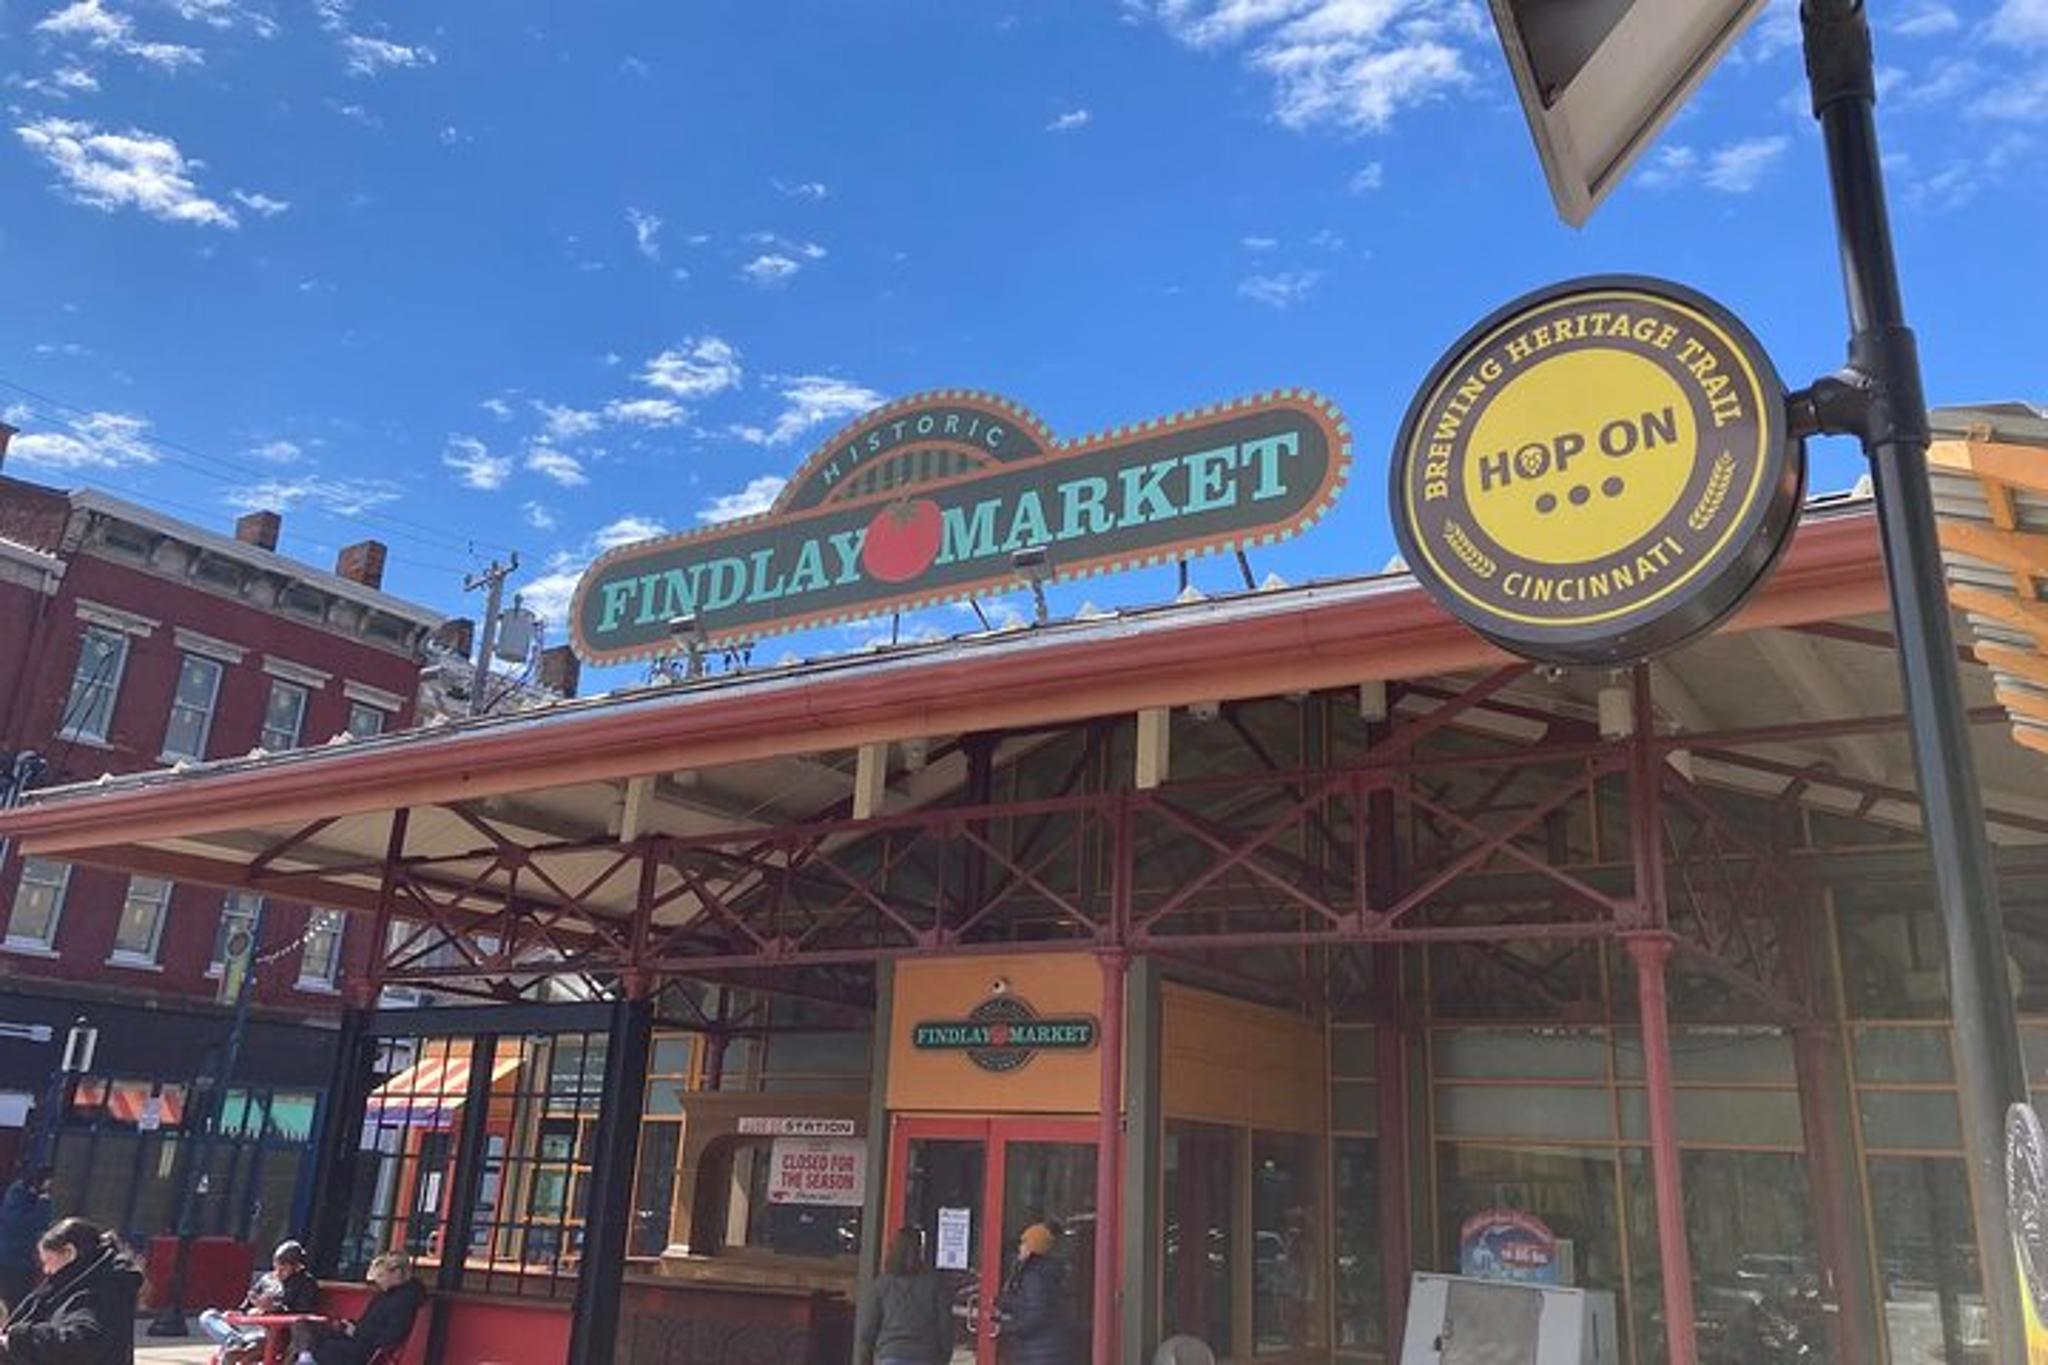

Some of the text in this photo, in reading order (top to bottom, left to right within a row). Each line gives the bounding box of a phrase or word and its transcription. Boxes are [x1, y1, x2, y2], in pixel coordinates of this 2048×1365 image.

[1425, 312, 1743, 501] BREWING HERITAGE TRAIL
[823, 415, 1003, 484] HISTORIC
[1478, 407, 1678, 491] HOP ON
[597, 432, 1299, 632] FINDLAY MARKET
[1503, 537, 1685, 603] CINCINNATI
[917, 1026, 1090, 1044] FINDLAY MARKET
[785, 1121, 852, 1133] STATION
[781, 1154, 854, 1172] CLOSED FOR
[781, 1171, 854, 1190] THE SEASON
